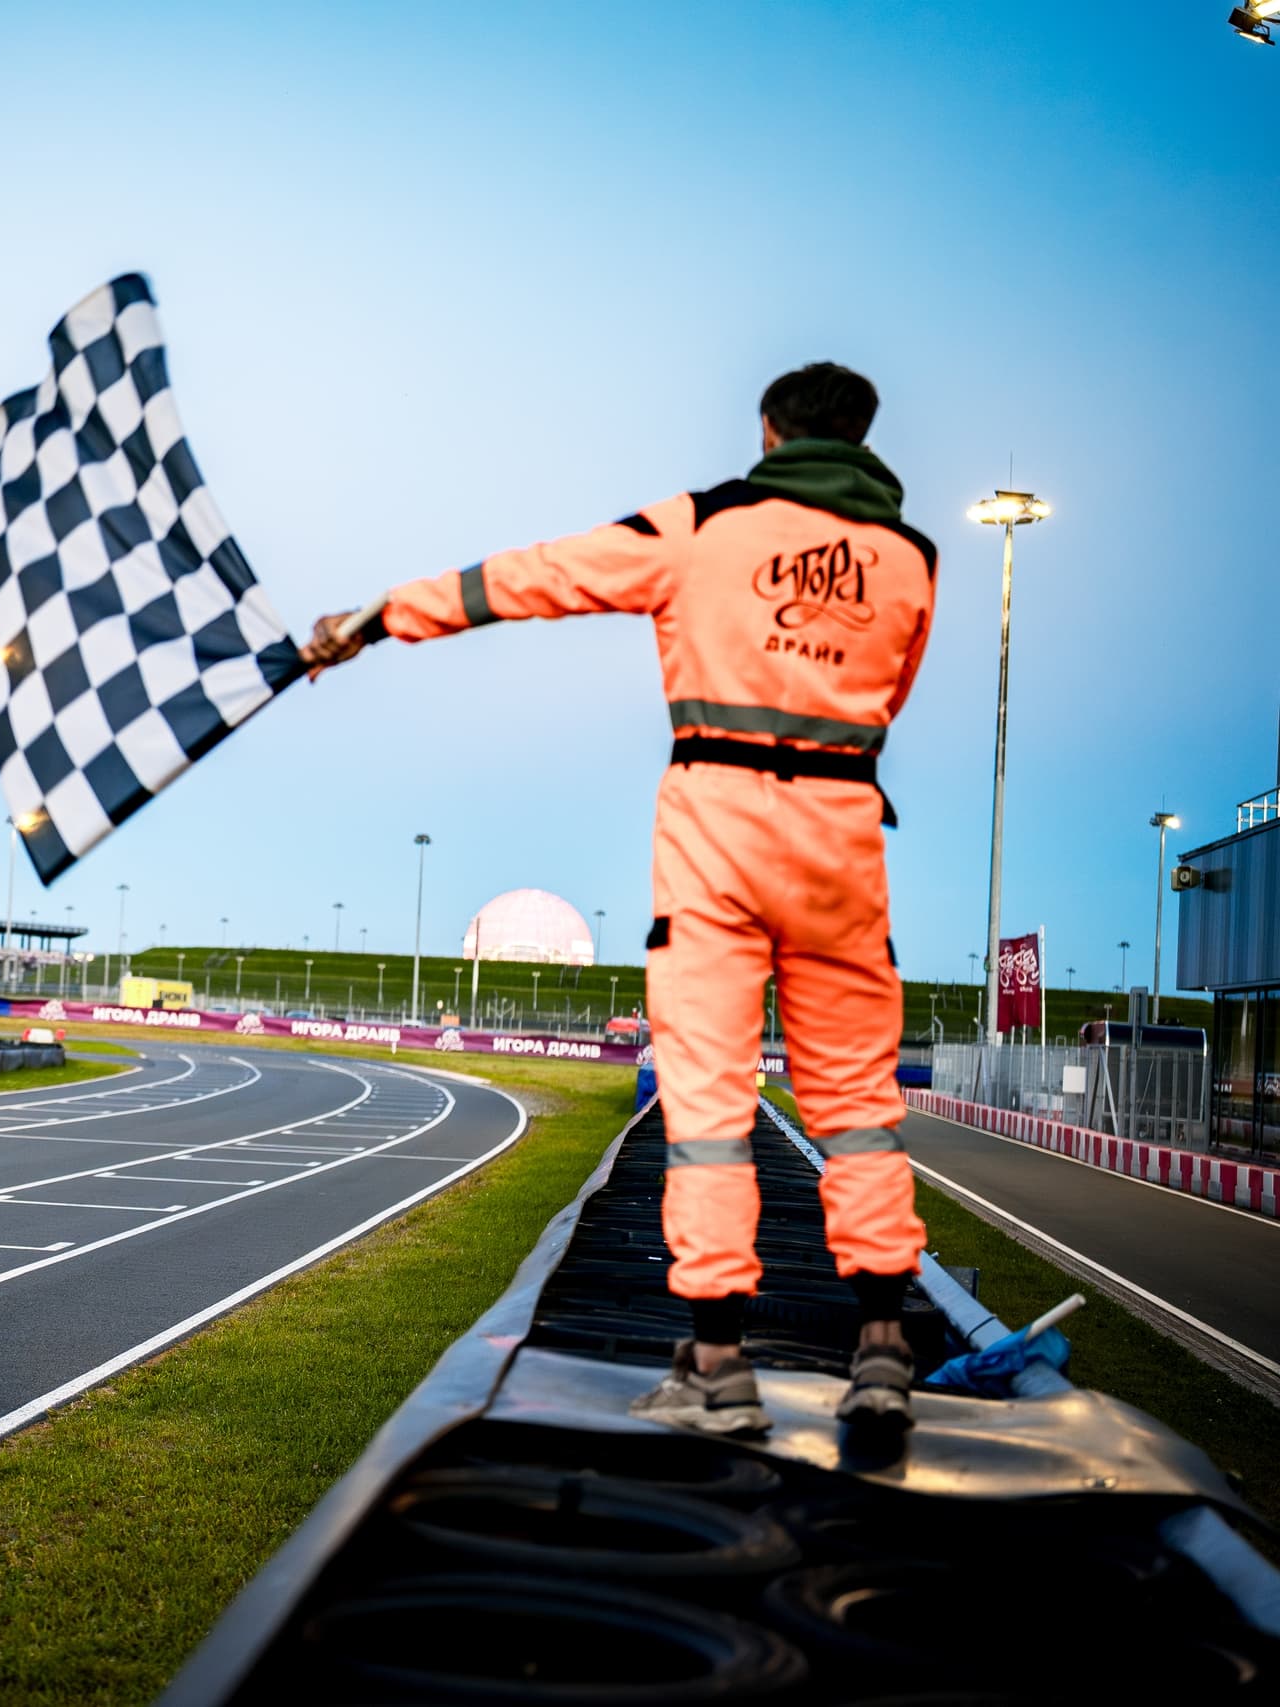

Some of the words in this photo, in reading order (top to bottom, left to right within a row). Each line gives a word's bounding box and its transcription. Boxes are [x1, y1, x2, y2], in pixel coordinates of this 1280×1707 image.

[92, 1007, 145, 1023] ИГОРА
[291, 1021, 343, 1037] ИГОРА
[493, 1037, 545, 1054] ИГОРА
